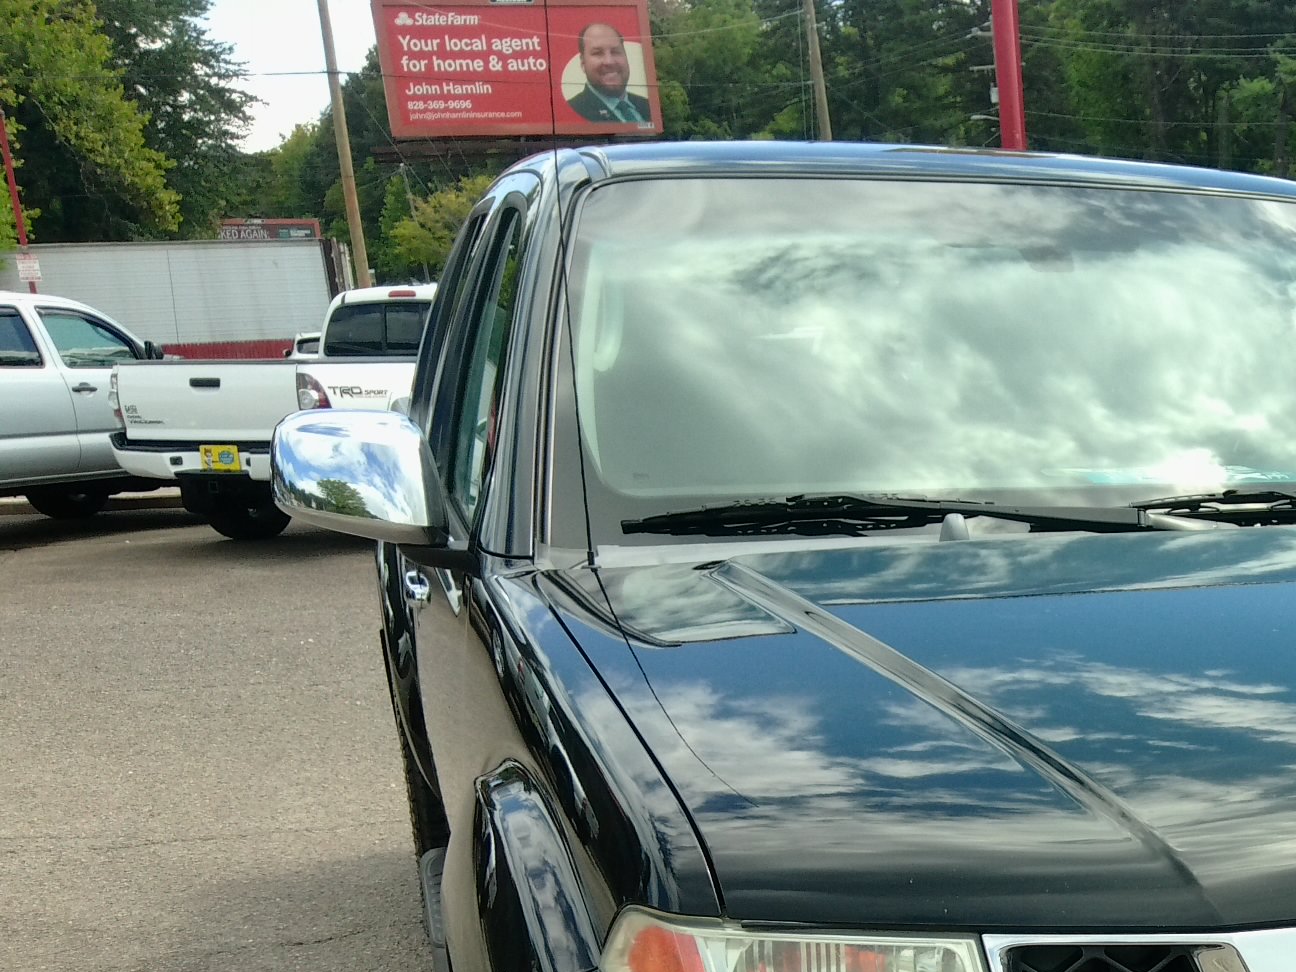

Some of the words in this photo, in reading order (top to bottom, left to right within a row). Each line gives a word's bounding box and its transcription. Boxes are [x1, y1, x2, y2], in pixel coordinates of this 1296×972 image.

[399, 35, 439, 52] Your
[445, 35, 486, 51] local
[491, 36, 541, 54] agent
[400, 55, 428, 72] for
[433, 56, 483, 72] home
[489, 56, 502, 71] &
[508, 57, 547, 71] auto
[405, 82, 440, 95] John
[442, 82, 492, 95] Hamlin
[407, 100, 472, 110] 828-369-9696
[327, 386, 362, 398] TRD
